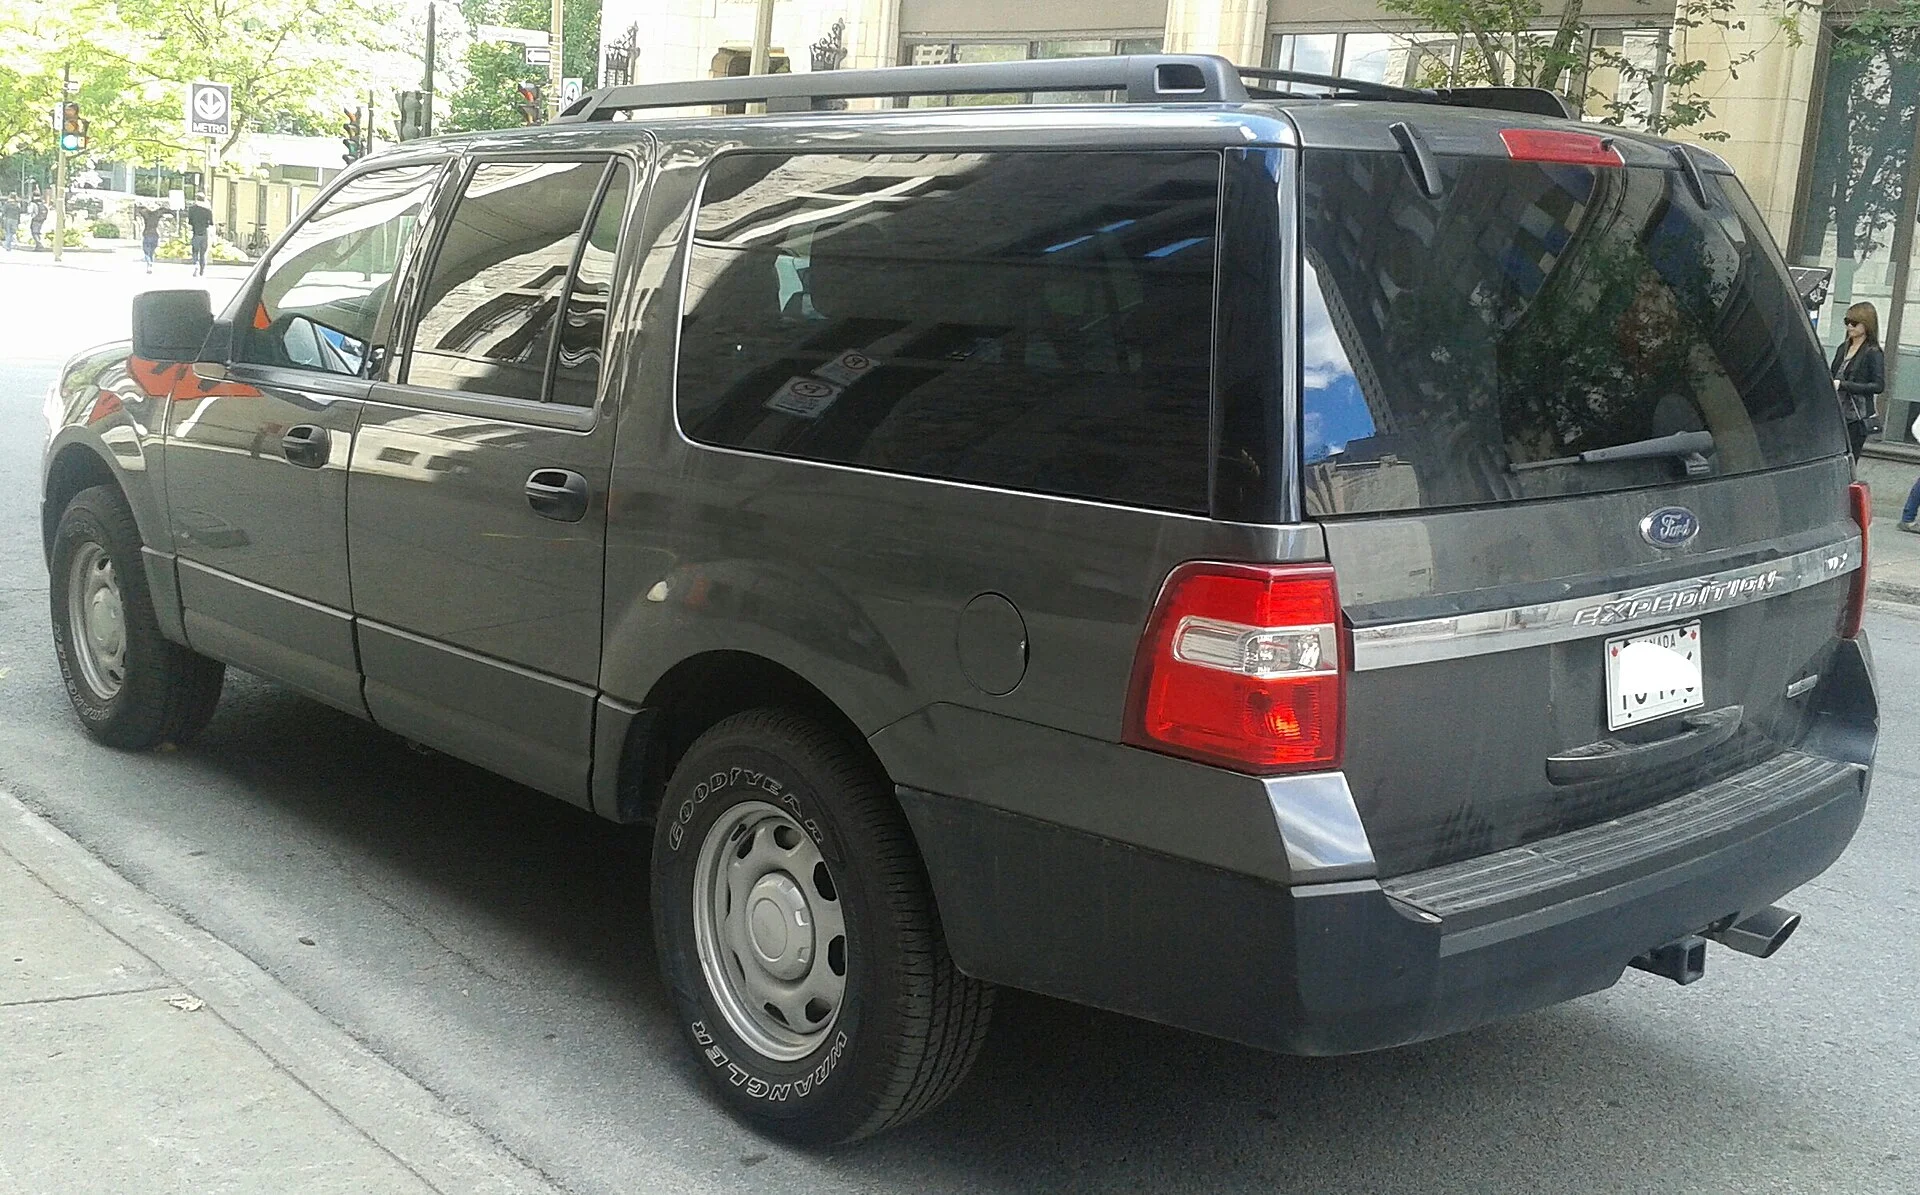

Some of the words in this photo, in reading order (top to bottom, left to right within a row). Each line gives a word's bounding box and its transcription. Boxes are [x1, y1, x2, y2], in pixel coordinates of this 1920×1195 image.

[193, 122, 227, 134] METRO
[1660, 514, 1690, 540] Ford
[1572, 569, 1778, 627] EXPEDITION
[669, 767, 824, 850] GOODYEAR
[692, 1021, 848, 1101] WRANGLER
